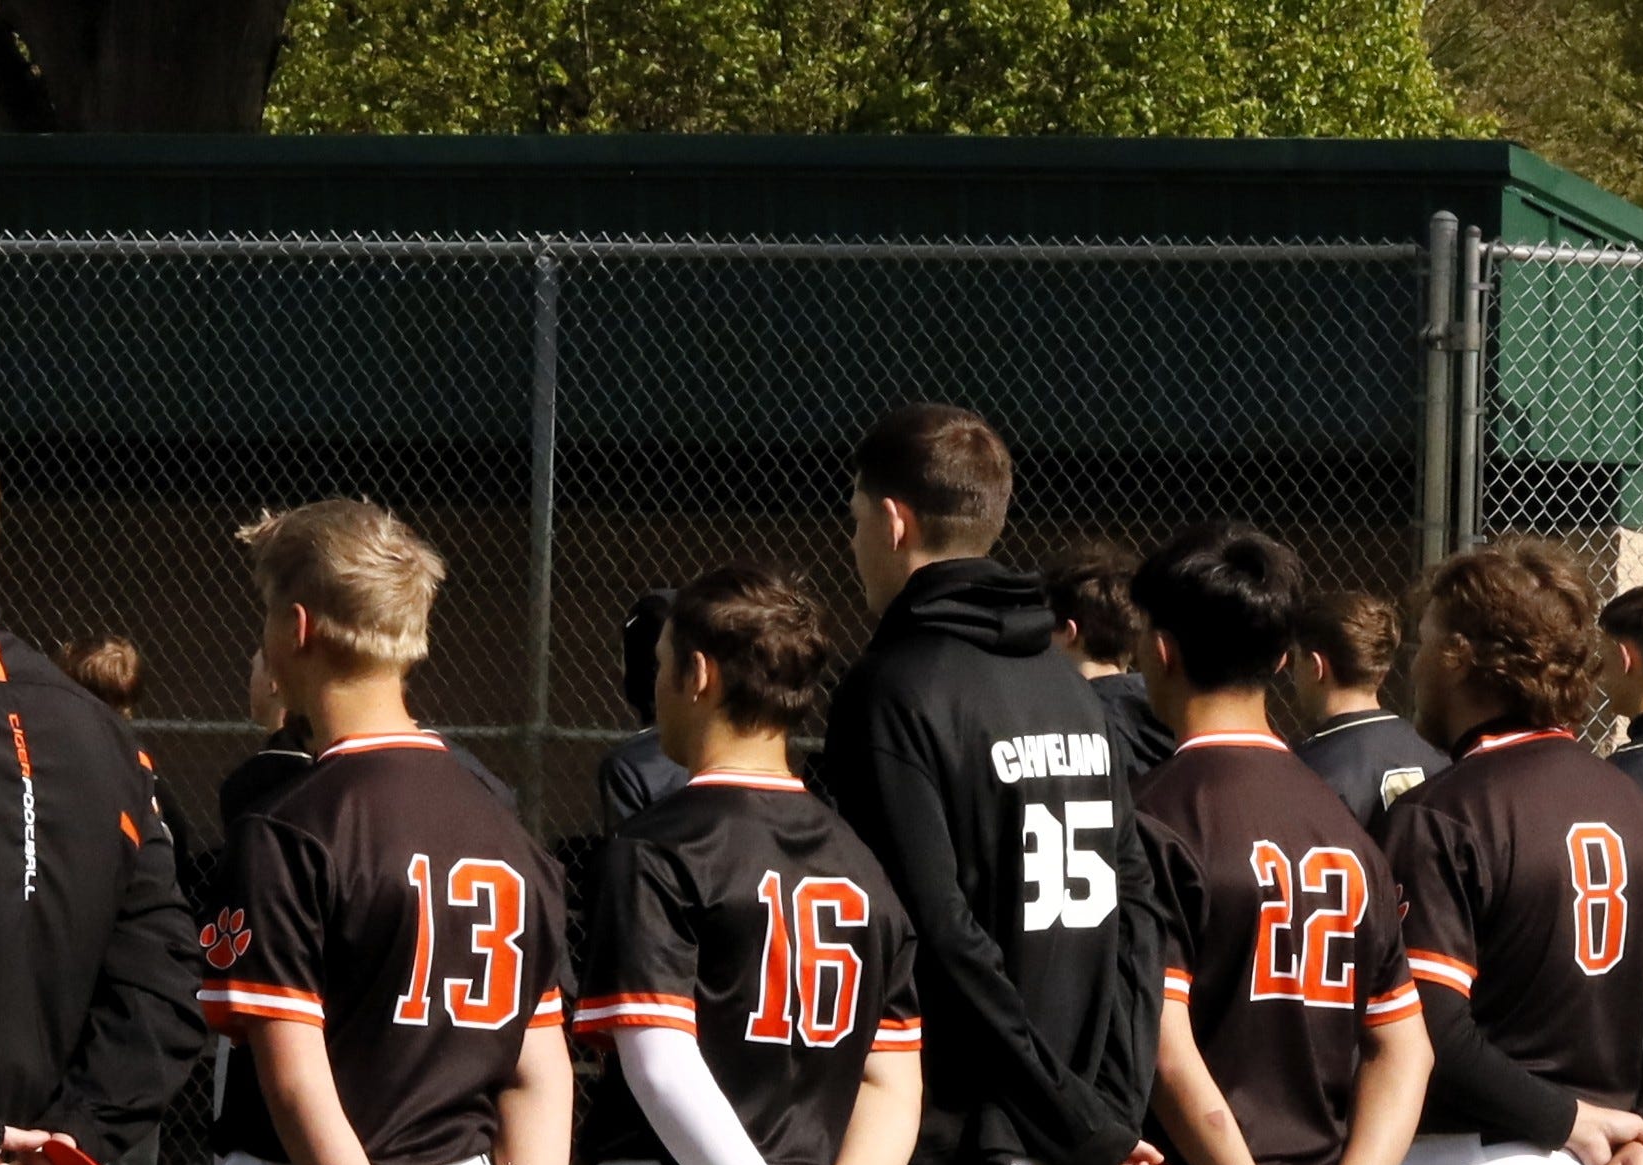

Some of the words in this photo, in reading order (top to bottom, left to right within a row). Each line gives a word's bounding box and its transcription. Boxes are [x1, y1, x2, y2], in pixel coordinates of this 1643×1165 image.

[392, 853, 525, 1030] 13
[745, 869, 870, 1048] 16
[1250, 839, 1369, 1009] 22
[1566, 822, 1628, 976] 8
